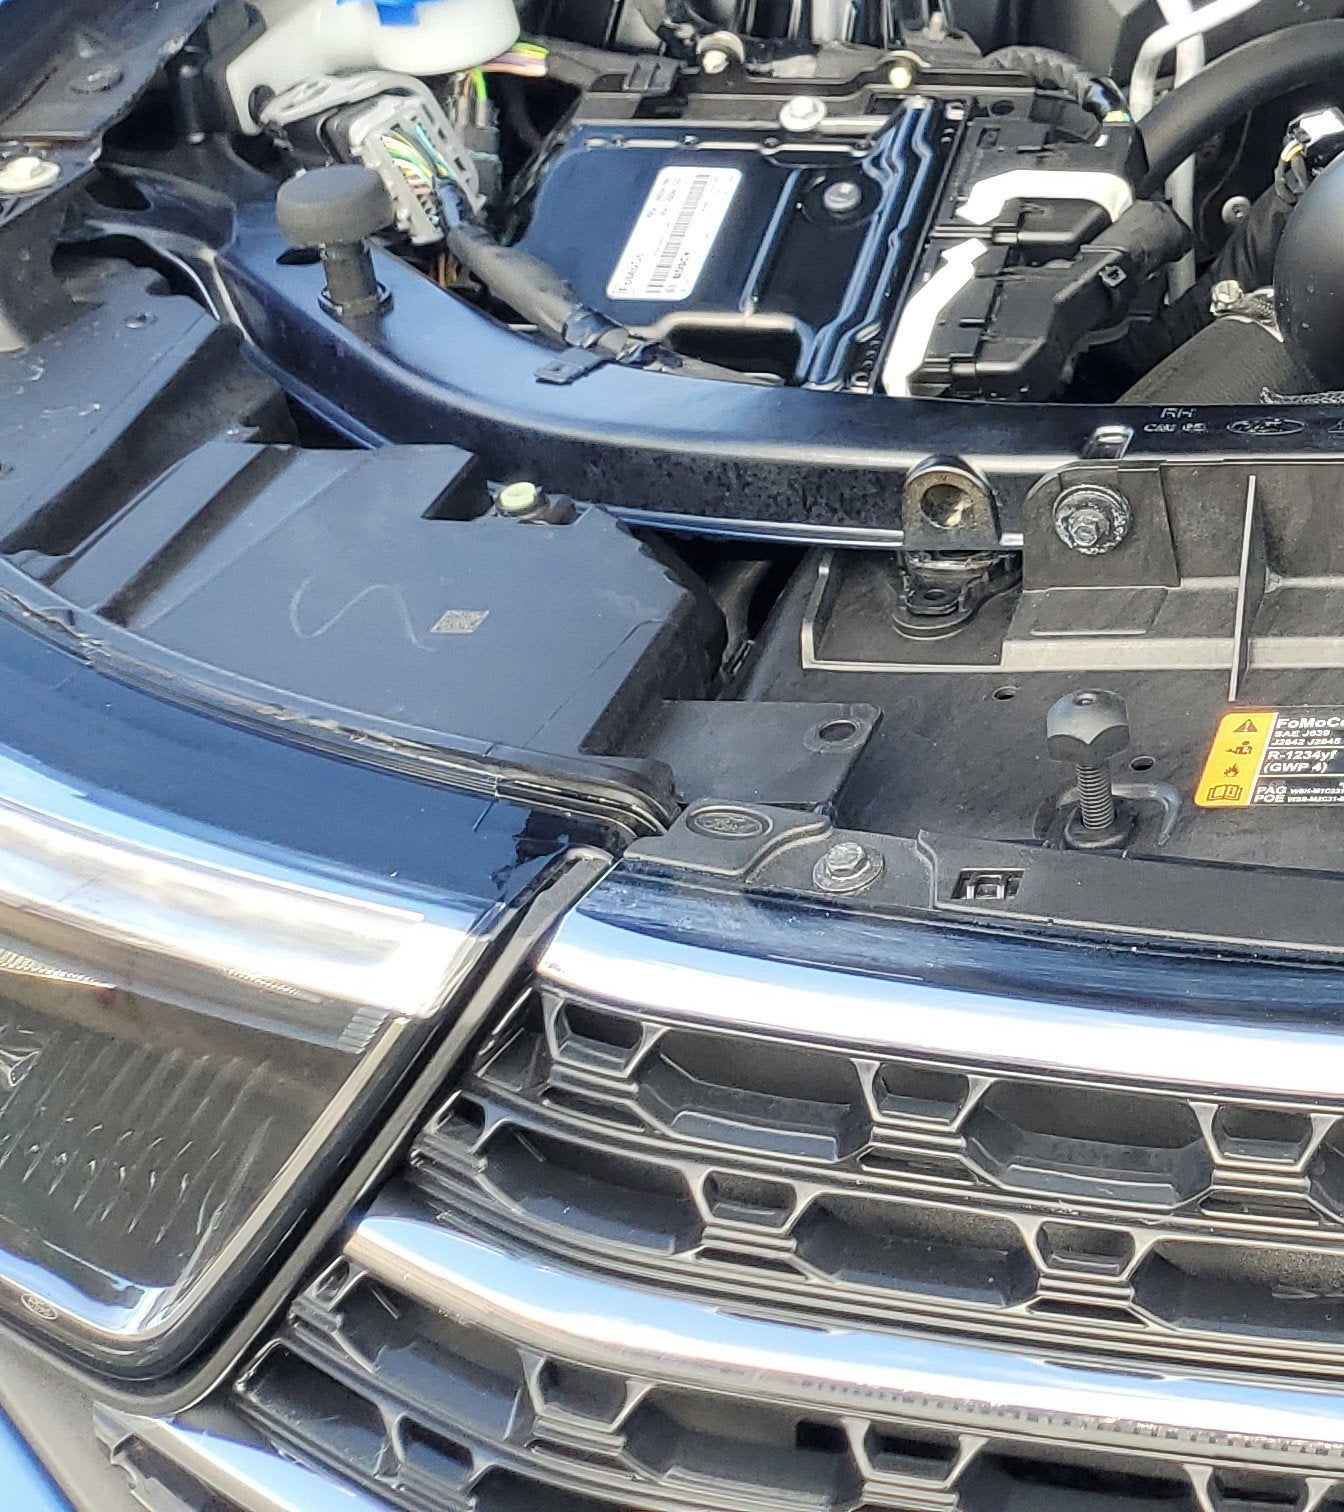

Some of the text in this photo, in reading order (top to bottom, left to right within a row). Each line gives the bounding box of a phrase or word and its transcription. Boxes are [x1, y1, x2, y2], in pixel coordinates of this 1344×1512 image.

[1267, 750, 1338, 761] R-1234yf
[1263, 761, 1328, 774] (GWP 4)
[1256, 785, 1287, 794] PAG
[1253, 794, 1286, 803] POE
